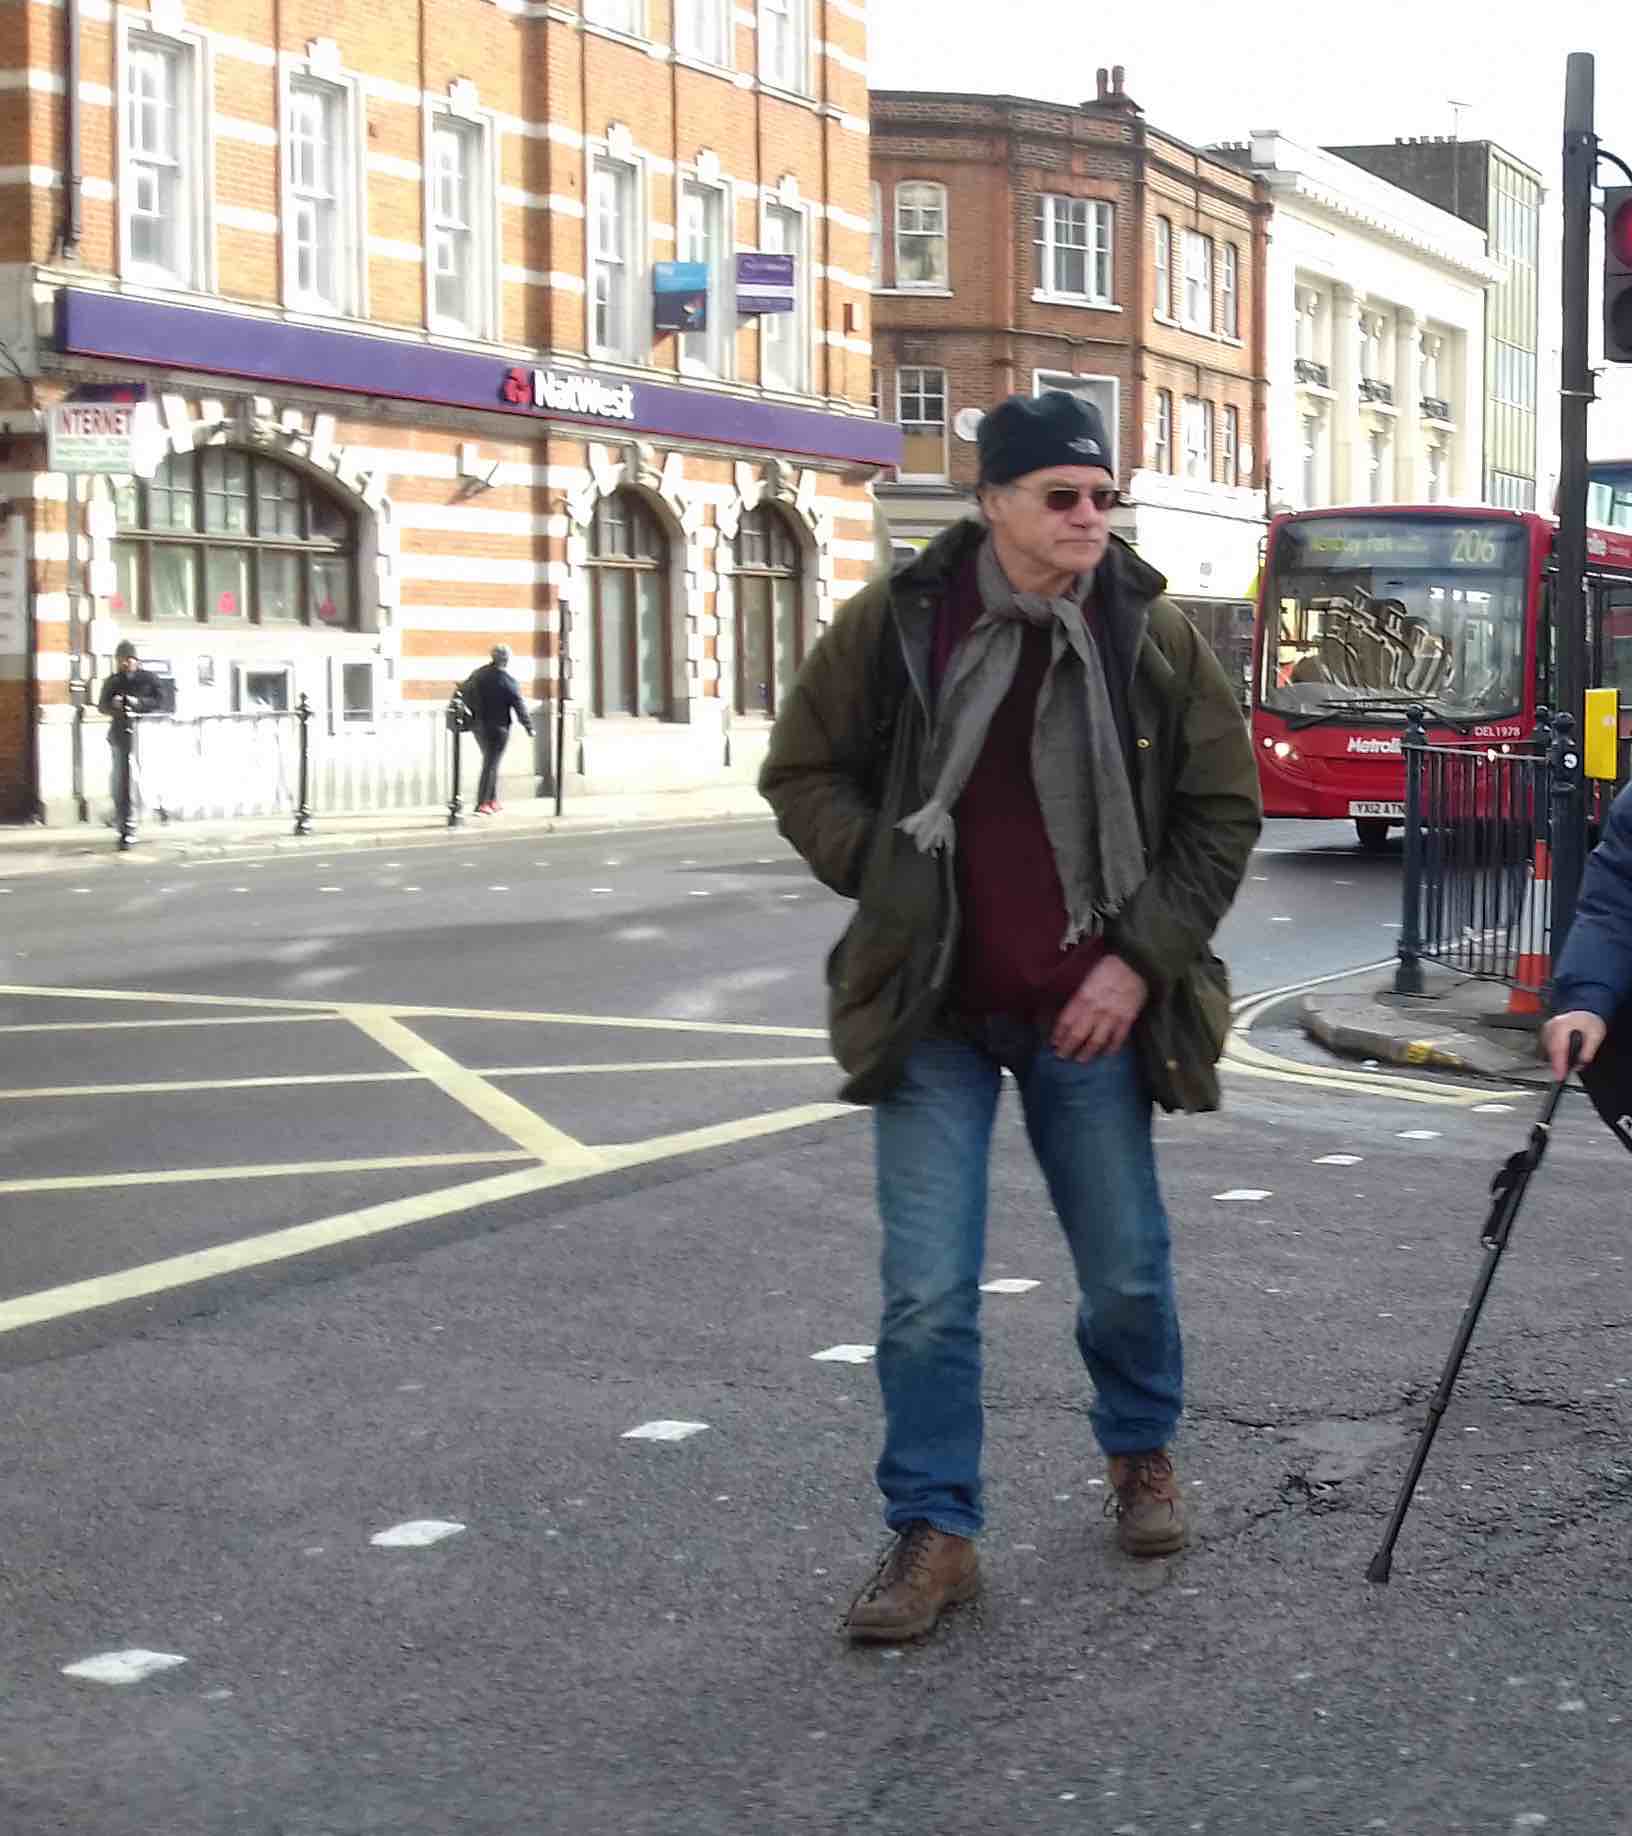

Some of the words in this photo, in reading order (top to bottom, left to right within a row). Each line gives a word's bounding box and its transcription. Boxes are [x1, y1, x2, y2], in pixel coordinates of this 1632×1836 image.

[534, 369, 635, 420] NatWest
[55, 408, 133, 434] INTERNET
[1452, 529, 1496, 563] 206
